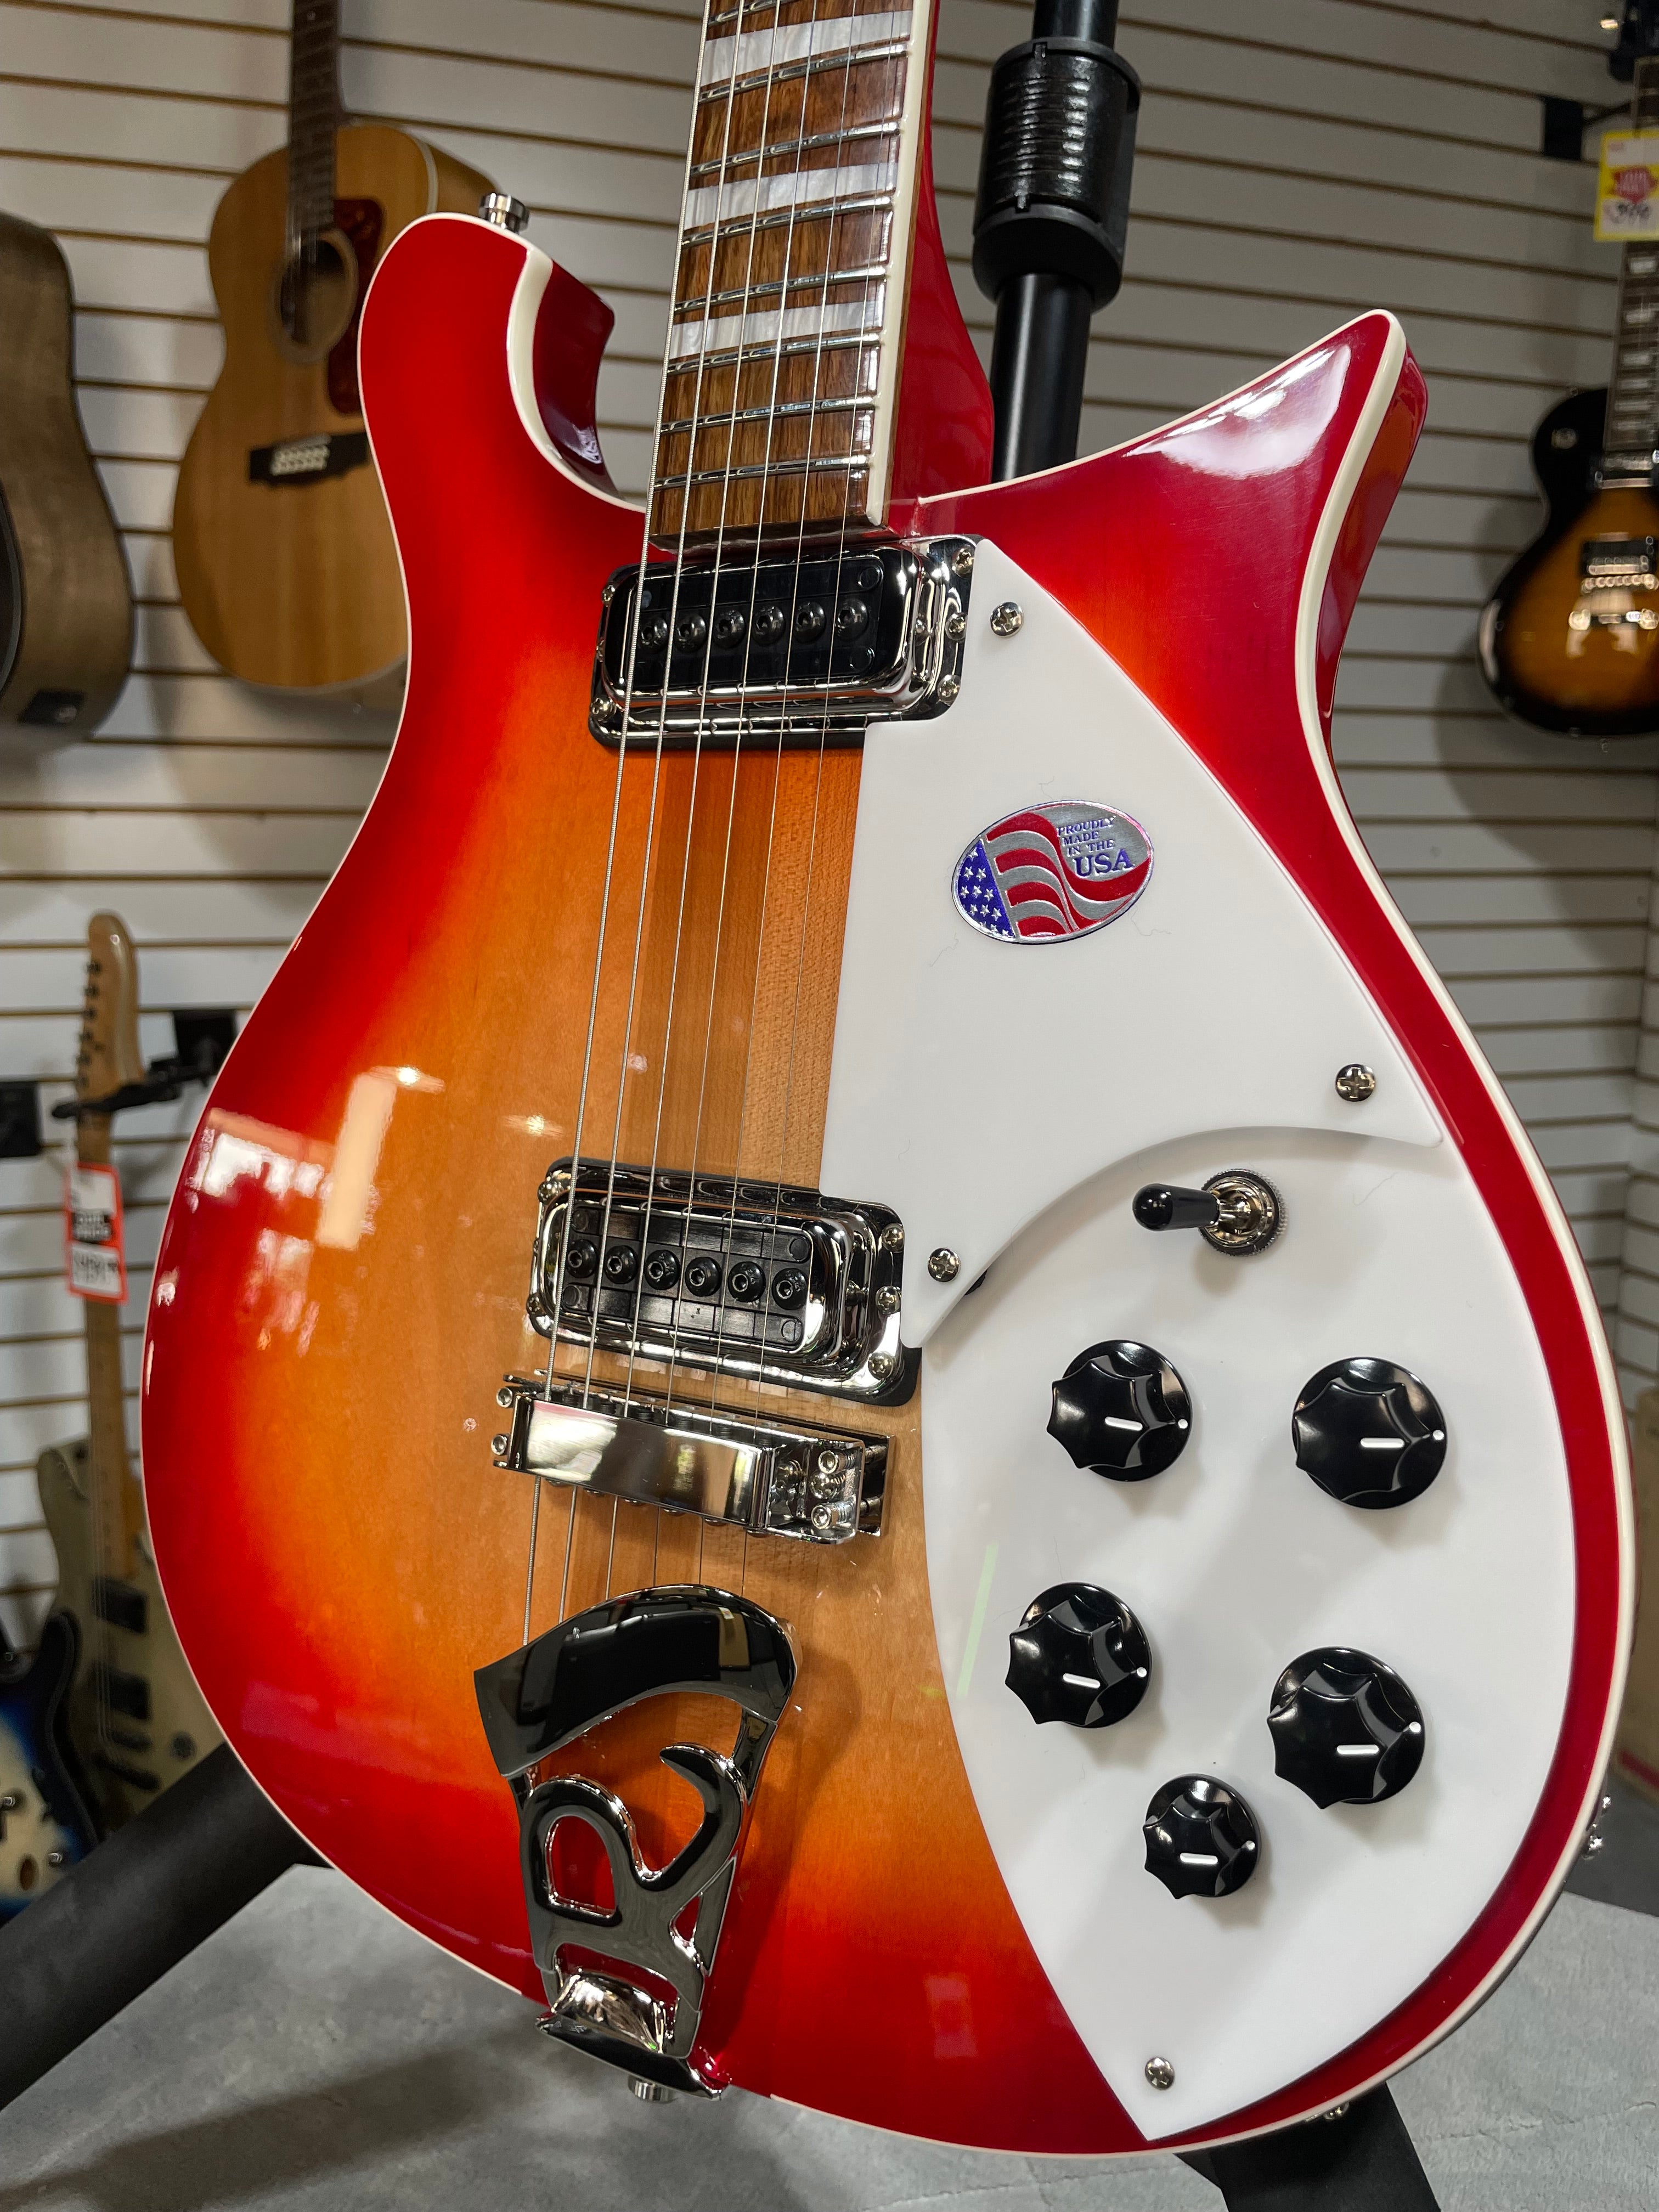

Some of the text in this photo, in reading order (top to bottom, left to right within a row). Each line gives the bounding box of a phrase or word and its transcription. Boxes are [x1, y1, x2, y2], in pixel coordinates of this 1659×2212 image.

[1057, 815, 1116, 837] PROUDLY
[1063, 831, 1100, 847] MADE
[1067, 839, 1115, 857] IN THE
[1073, 848, 1135, 878] USA
